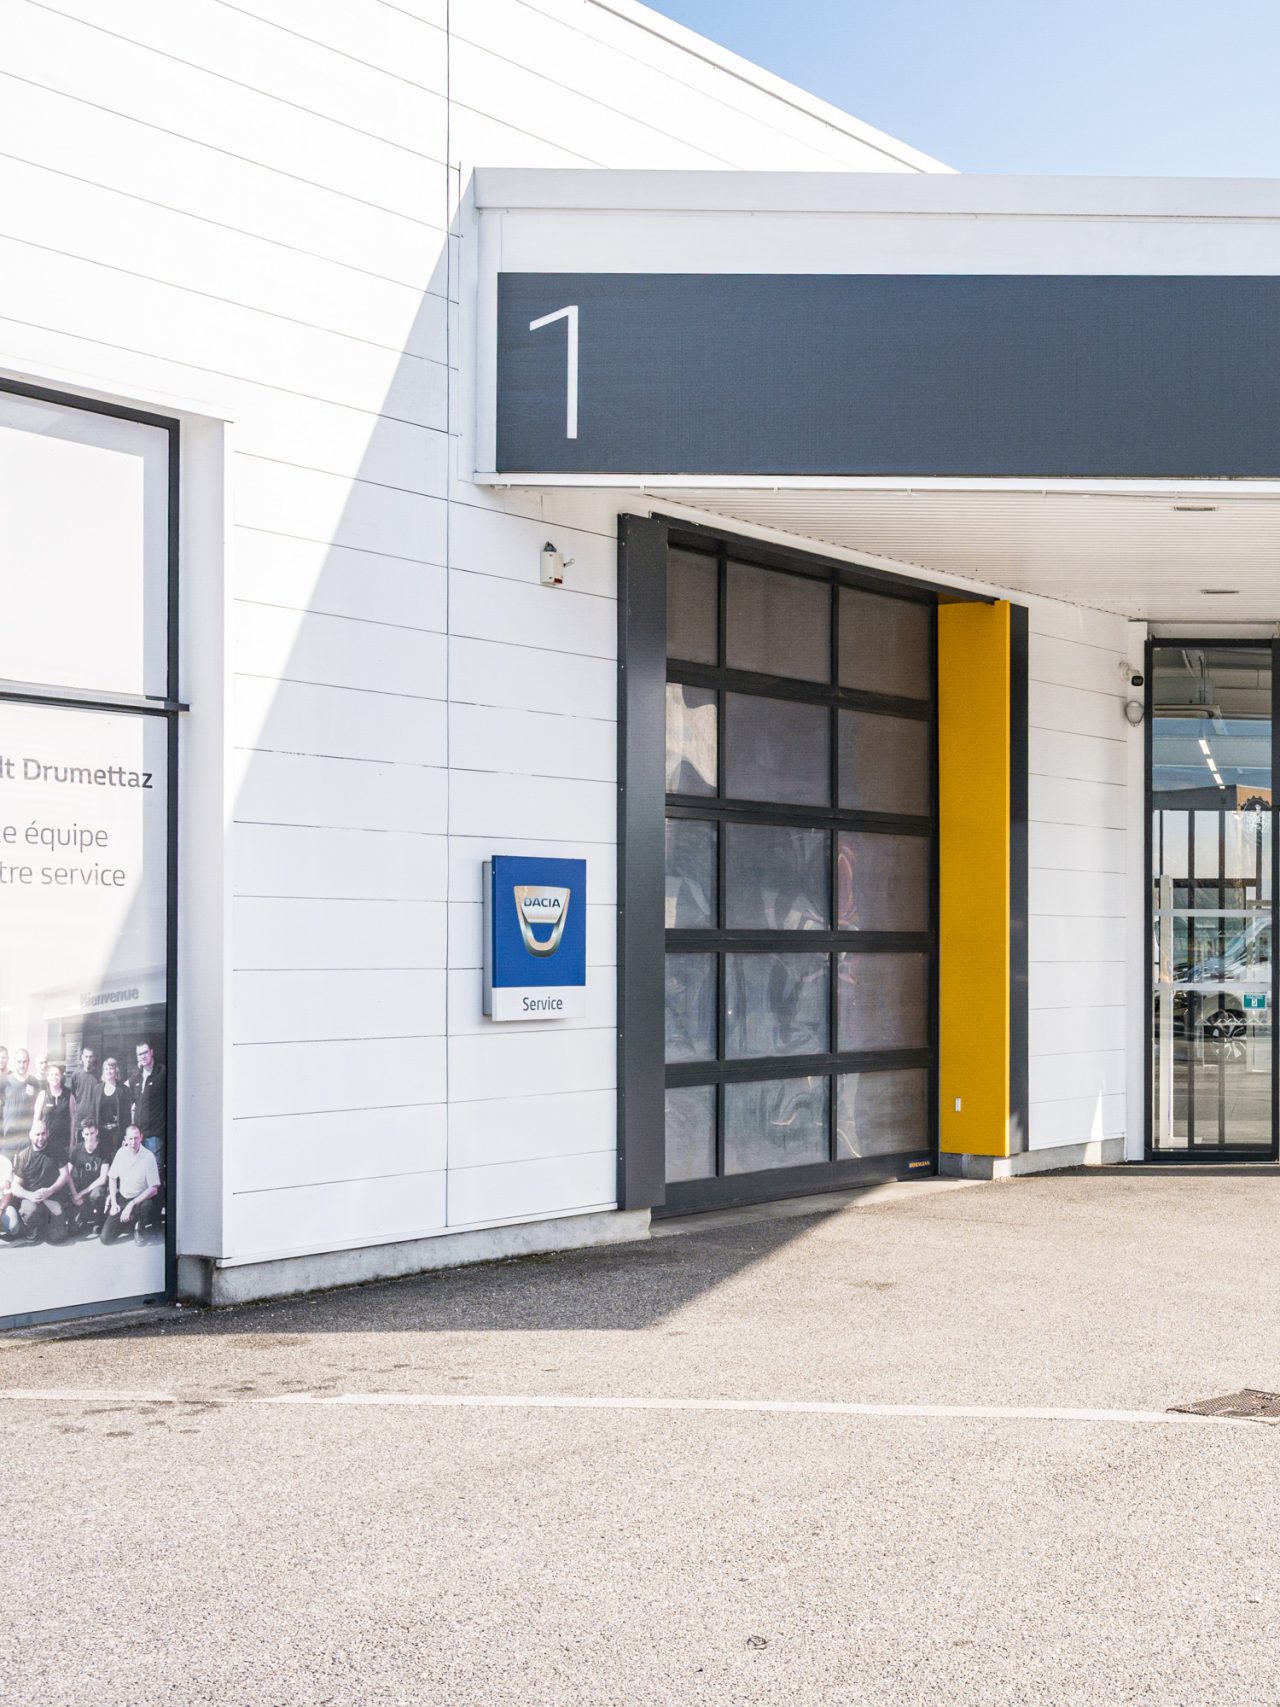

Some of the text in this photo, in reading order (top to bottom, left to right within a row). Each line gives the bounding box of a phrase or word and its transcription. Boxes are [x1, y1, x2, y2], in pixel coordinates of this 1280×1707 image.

[529, 305, 579, 439] 1
[22, 758, 153, 789] Drumettaz
[24, 820, 109, 853] équipe
[41, 862, 126, 887] service
[523, 896, 562, 909] DACIA
[80, 987, 140, 1007] Bienvenue
[522, 996, 564, 1012] Service
